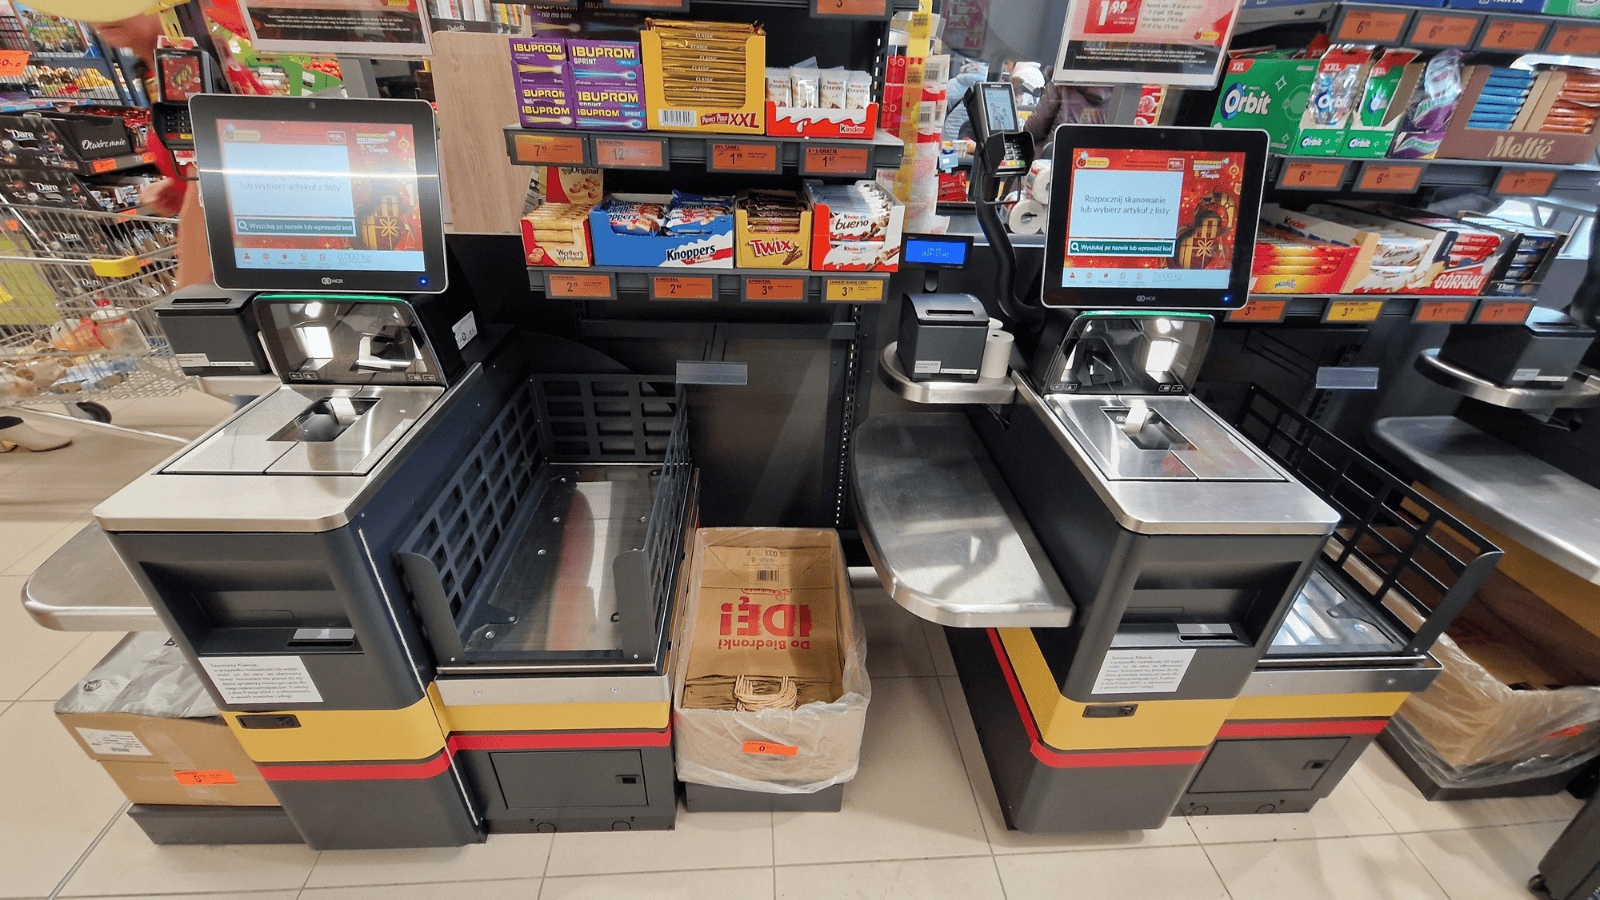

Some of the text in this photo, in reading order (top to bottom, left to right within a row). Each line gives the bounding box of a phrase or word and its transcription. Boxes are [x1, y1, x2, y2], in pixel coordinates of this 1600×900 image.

[513, 43, 562, 53] IBUPROM
[571, 46, 635, 59] IBUPROM
[573, 57, 597, 65] SPRINT
[1231, 62, 1245, 72] XXL
[1322, 63, 1342, 72] XXL
[577, 91, 639, 103] IBUPROM
[1220, 82, 1272, 121] Orbit
[521, 105, 571, 115] IBUPROM
[577, 108, 620, 117] IBUPROM
[729, 112, 760, 129] XXL
[7, 128, 35, 139] Dare
[81, 138, 126, 150] Otwórz mnie
[1300, 135, 1322, 148] Orbit
[1348, 137, 1372, 150] Orbit
[534, 144, 542, 157] 7
[730, 152, 735, 165] 1
[822, 156, 827, 168] 1
[571, 166, 599, 176] Original
[31, 181, 59, 192] Dare
[324, 183, 342, 193] listy
[1084, 194, 1166, 205] Rozpocznij skanowanie
[1080, 204, 1091, 214] lub
[1092, 205, 1121, 215] wybierz
[1122, 206, 1149, 215] artykuł
[1154, 206, 1170, 216] listy
[249, 223, 276, 231] Wyszukaj
[303, 223, 313, 231] lub
[835, 218, 869, 231] bueno
[666, 244, 716, 262] Knoppers
[1080, 244, 1103, 252] Wyszukaj
[566, 282, 573, 292] 2
[669, 284, 676, 294] 2
[761, 285, 768, 296] 3
[841, 286, 848, 297] 3
[1244, 306, 1252, 316] 3
[1341, 307, 1348, 317] 3
[720, 595, 813, 638] IDĘ!
[718, 638, 811, 651] Do Biedronki
